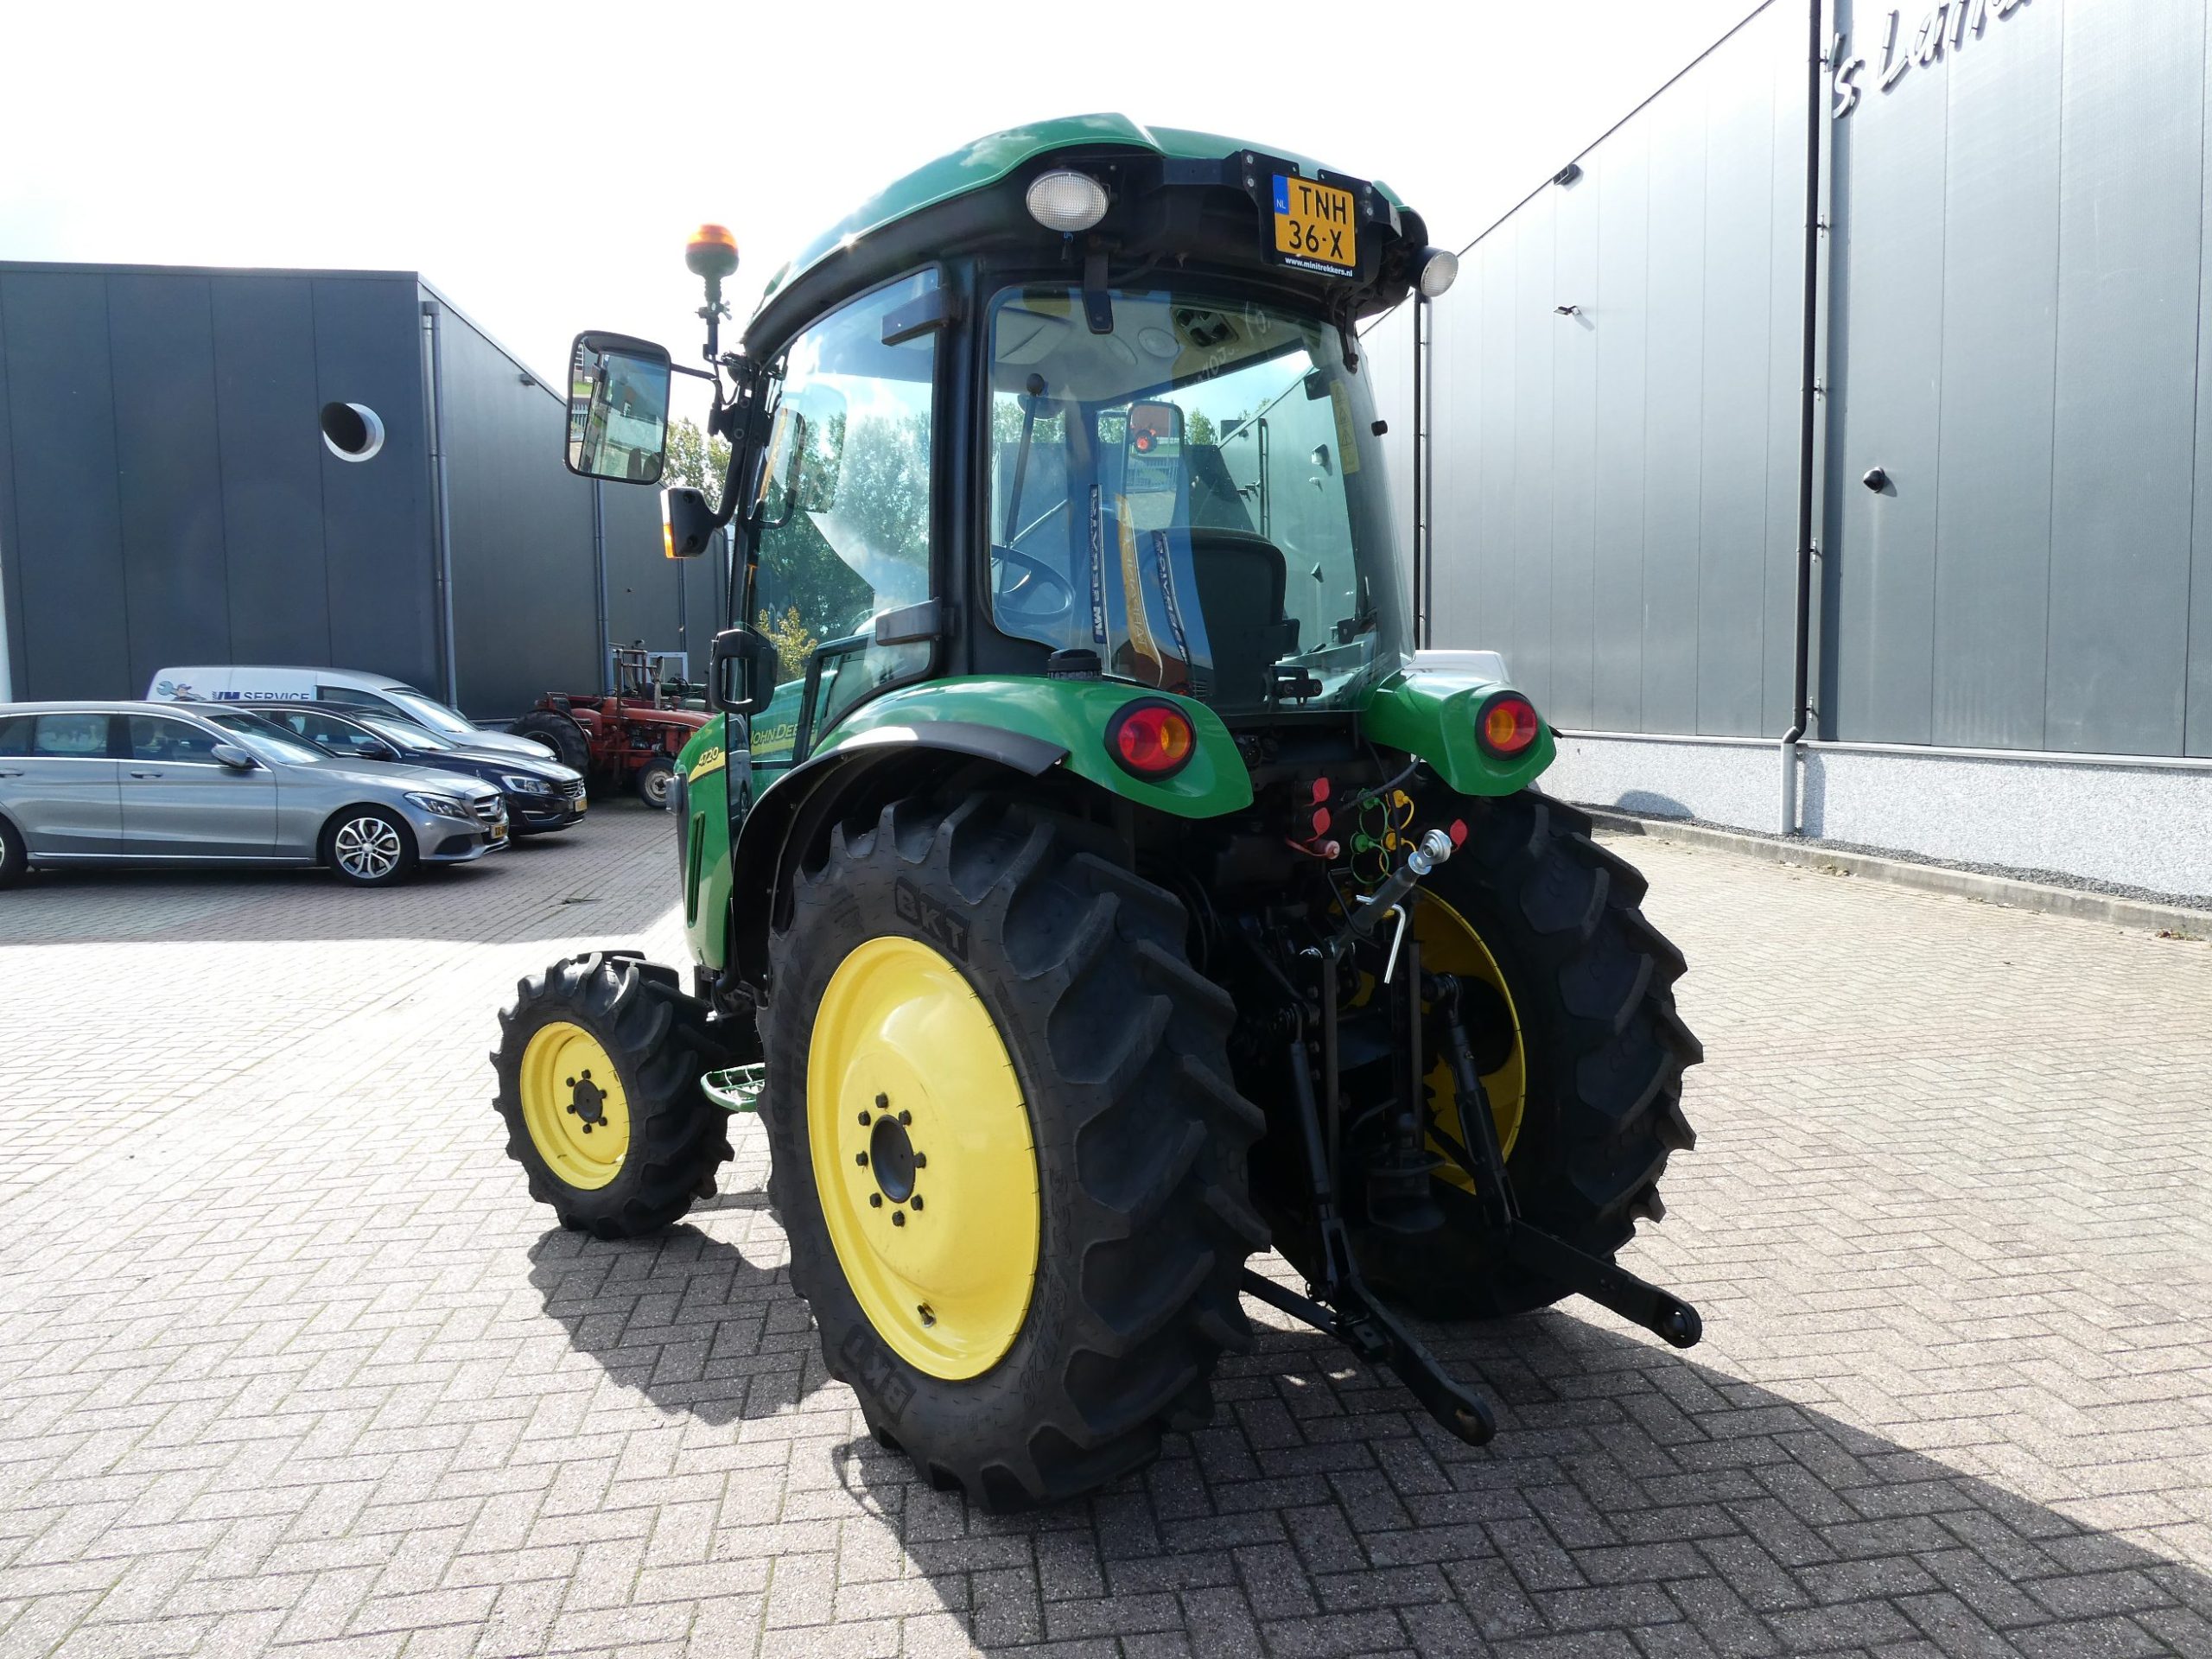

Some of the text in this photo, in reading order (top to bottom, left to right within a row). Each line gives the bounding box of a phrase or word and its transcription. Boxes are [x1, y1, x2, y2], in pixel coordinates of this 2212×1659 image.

[1276, 199, 1287, 209] NL
[1298, 185, 1346, 225] TNH
[1288, 219, 1344, 259] 36-X
[1285, 257, 1353, 277] www.minitrekkers.nl
[698, 746, 719, 767] 4720
[896, 878, 967, 957] BKT
